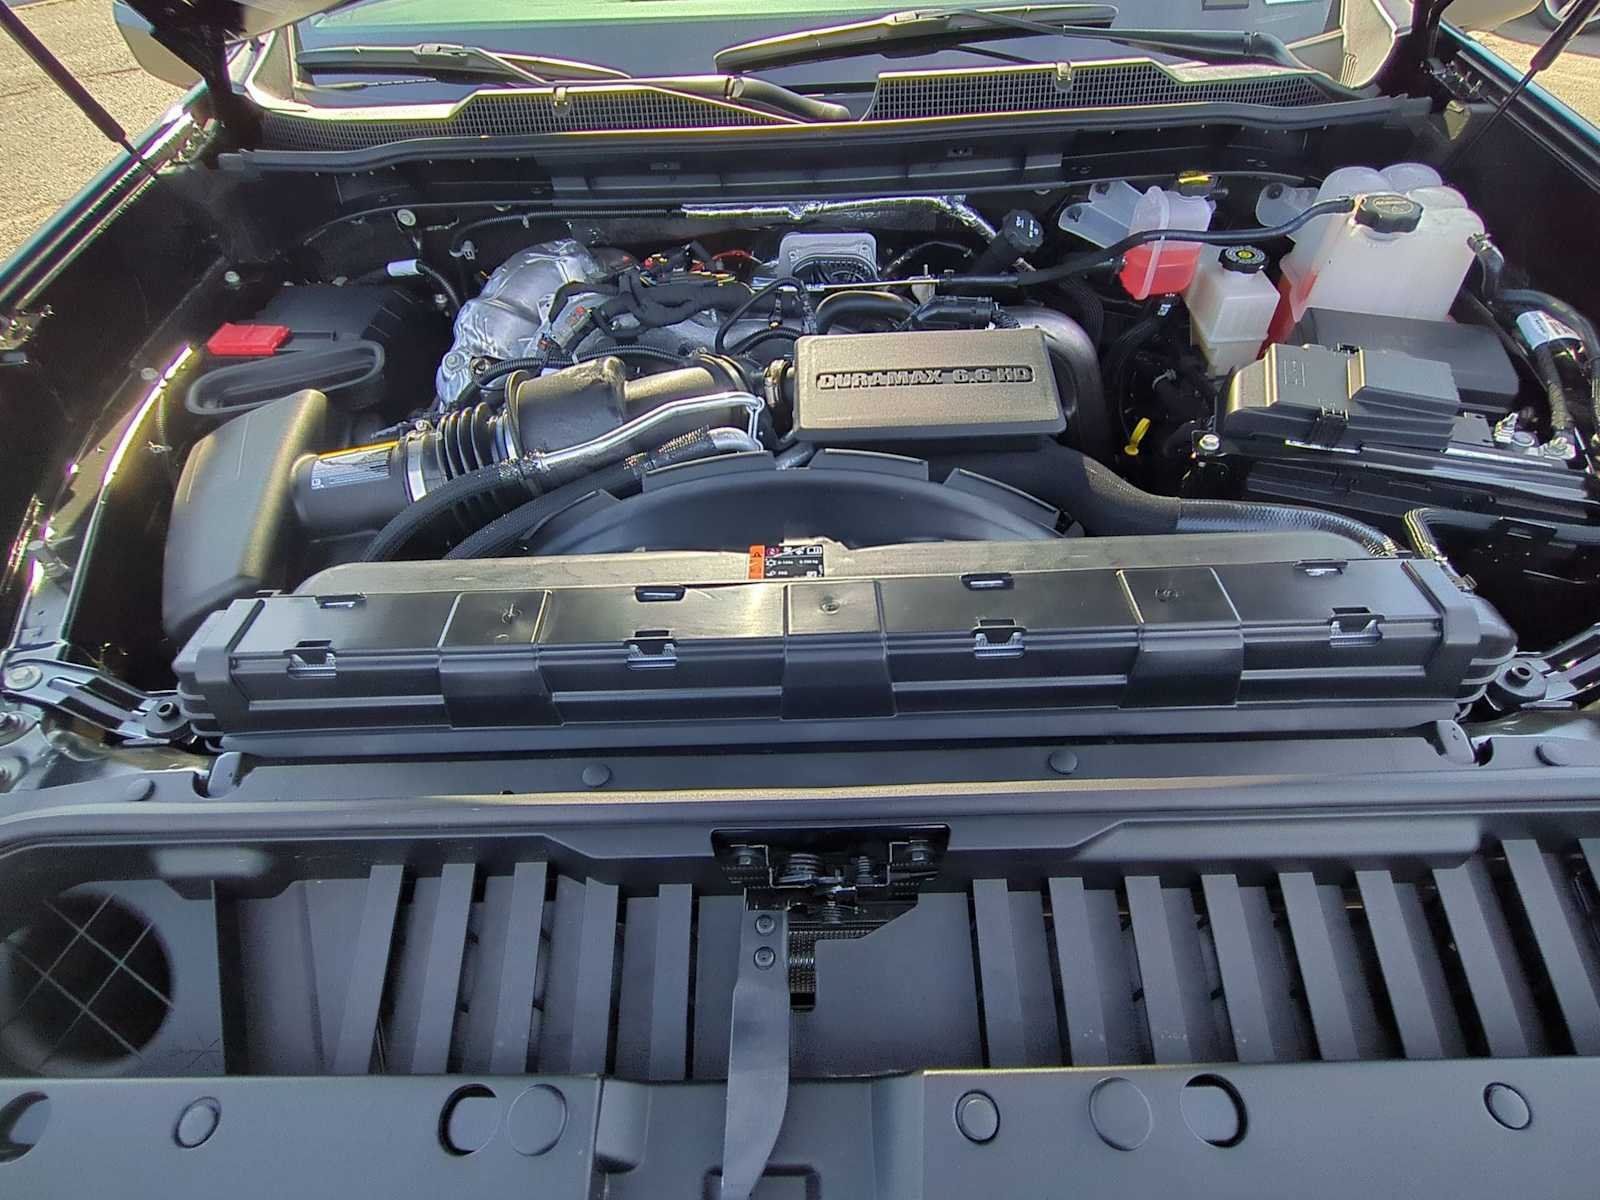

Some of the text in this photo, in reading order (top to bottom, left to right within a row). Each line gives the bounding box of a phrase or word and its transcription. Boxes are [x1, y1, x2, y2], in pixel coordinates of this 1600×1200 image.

[818, 367, 1032, 390] DURAMAX 6.6 HD
